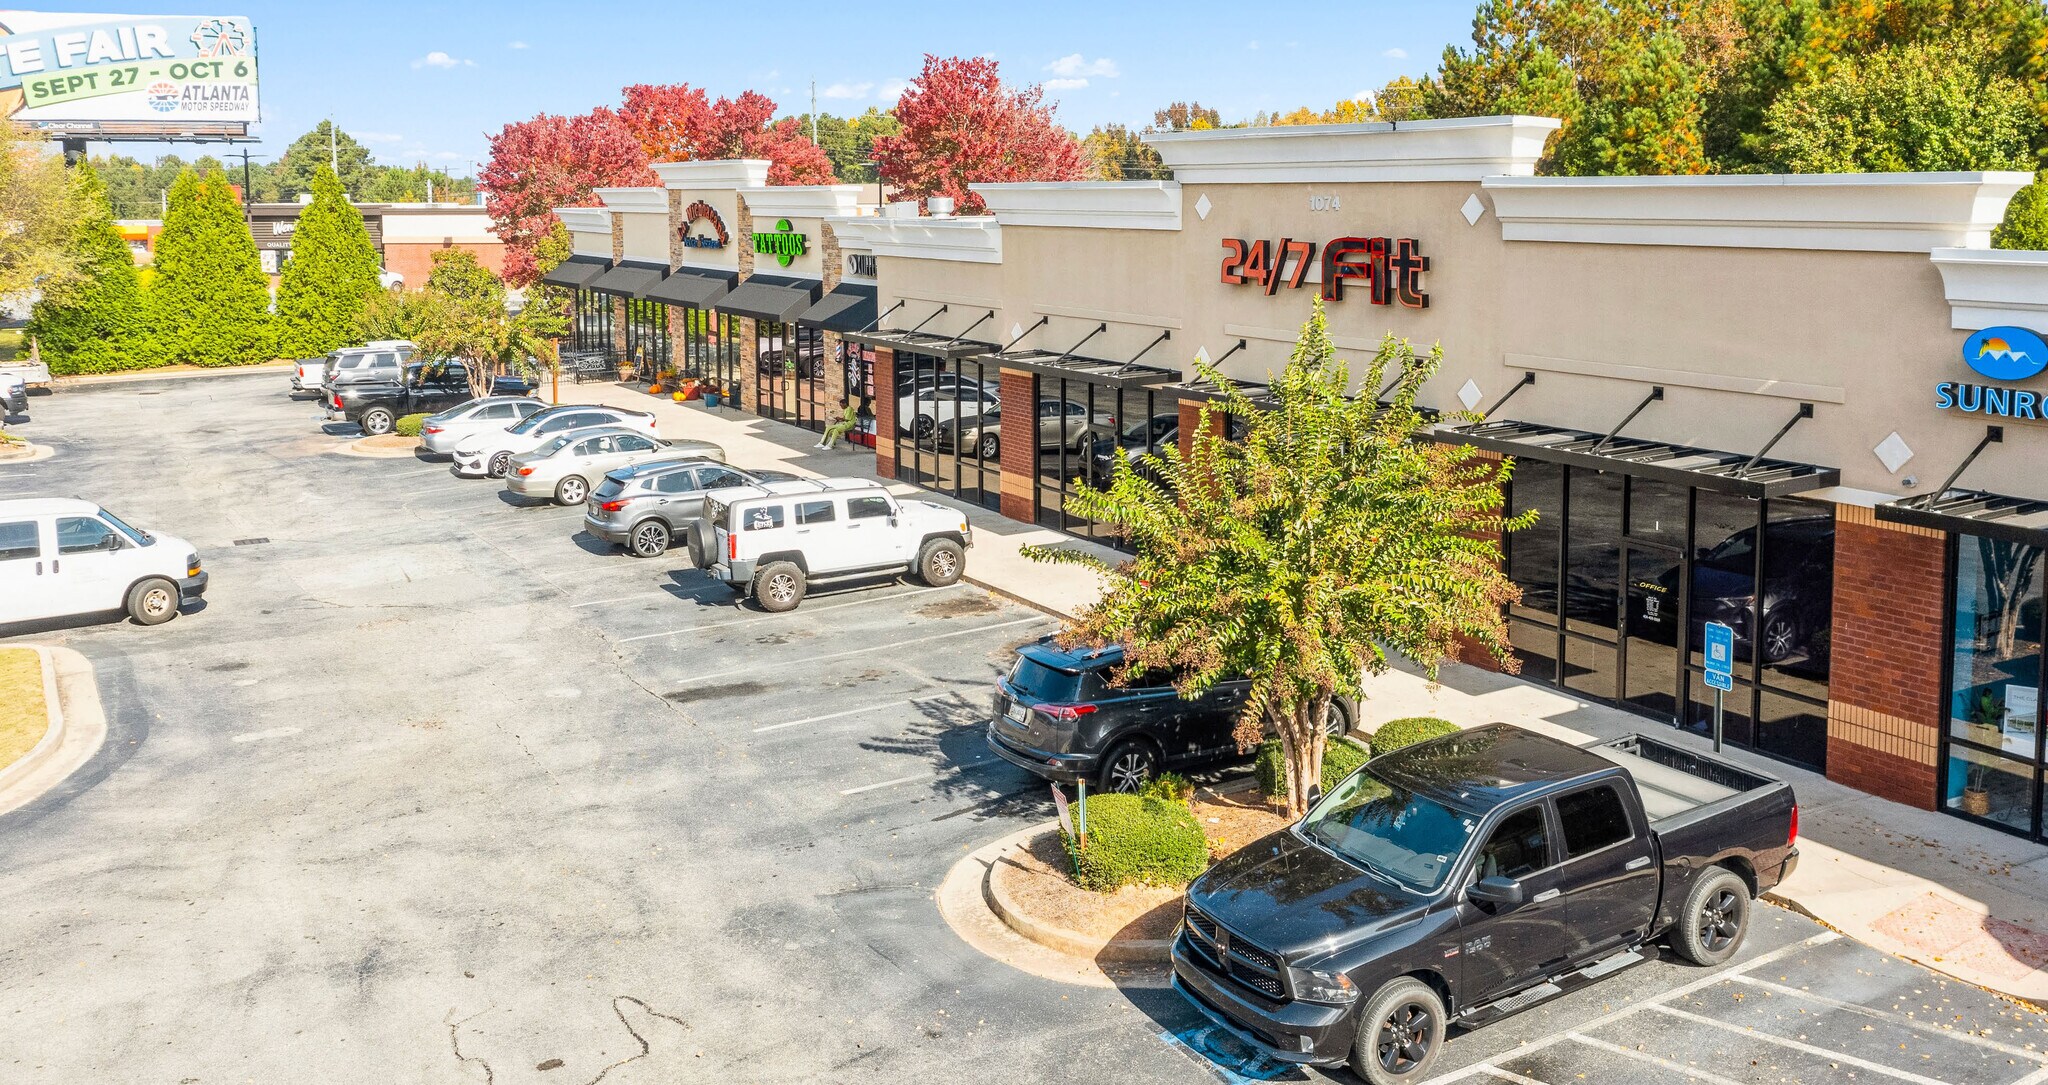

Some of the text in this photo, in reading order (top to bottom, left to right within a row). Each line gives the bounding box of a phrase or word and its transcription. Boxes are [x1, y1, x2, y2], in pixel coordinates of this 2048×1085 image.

[53, 24, 175, 68] FAIR
[32, 72, 99, 99] SEPT
[109, 67, 139, 87] 27
[169, 61, 224, 80] OCT
[233, 61, 249, 78] 6
[181, 84, 250, 101] ATLANTA
[181, 101, 250, 112] MOTOR SPEEDWAY
[48, 121, 94, 129] Clear Channel
[1309, 196, 1341, 211] 1074
[272, 220, 297, 236] Wen
[752, 233, 804, 256] TATTOOS
[1220, 236, 1430, 308] 24/7 Fit
[1640, 582, 1668, 593] OFFICE
[1711, 673, 1725, 683] VAN
